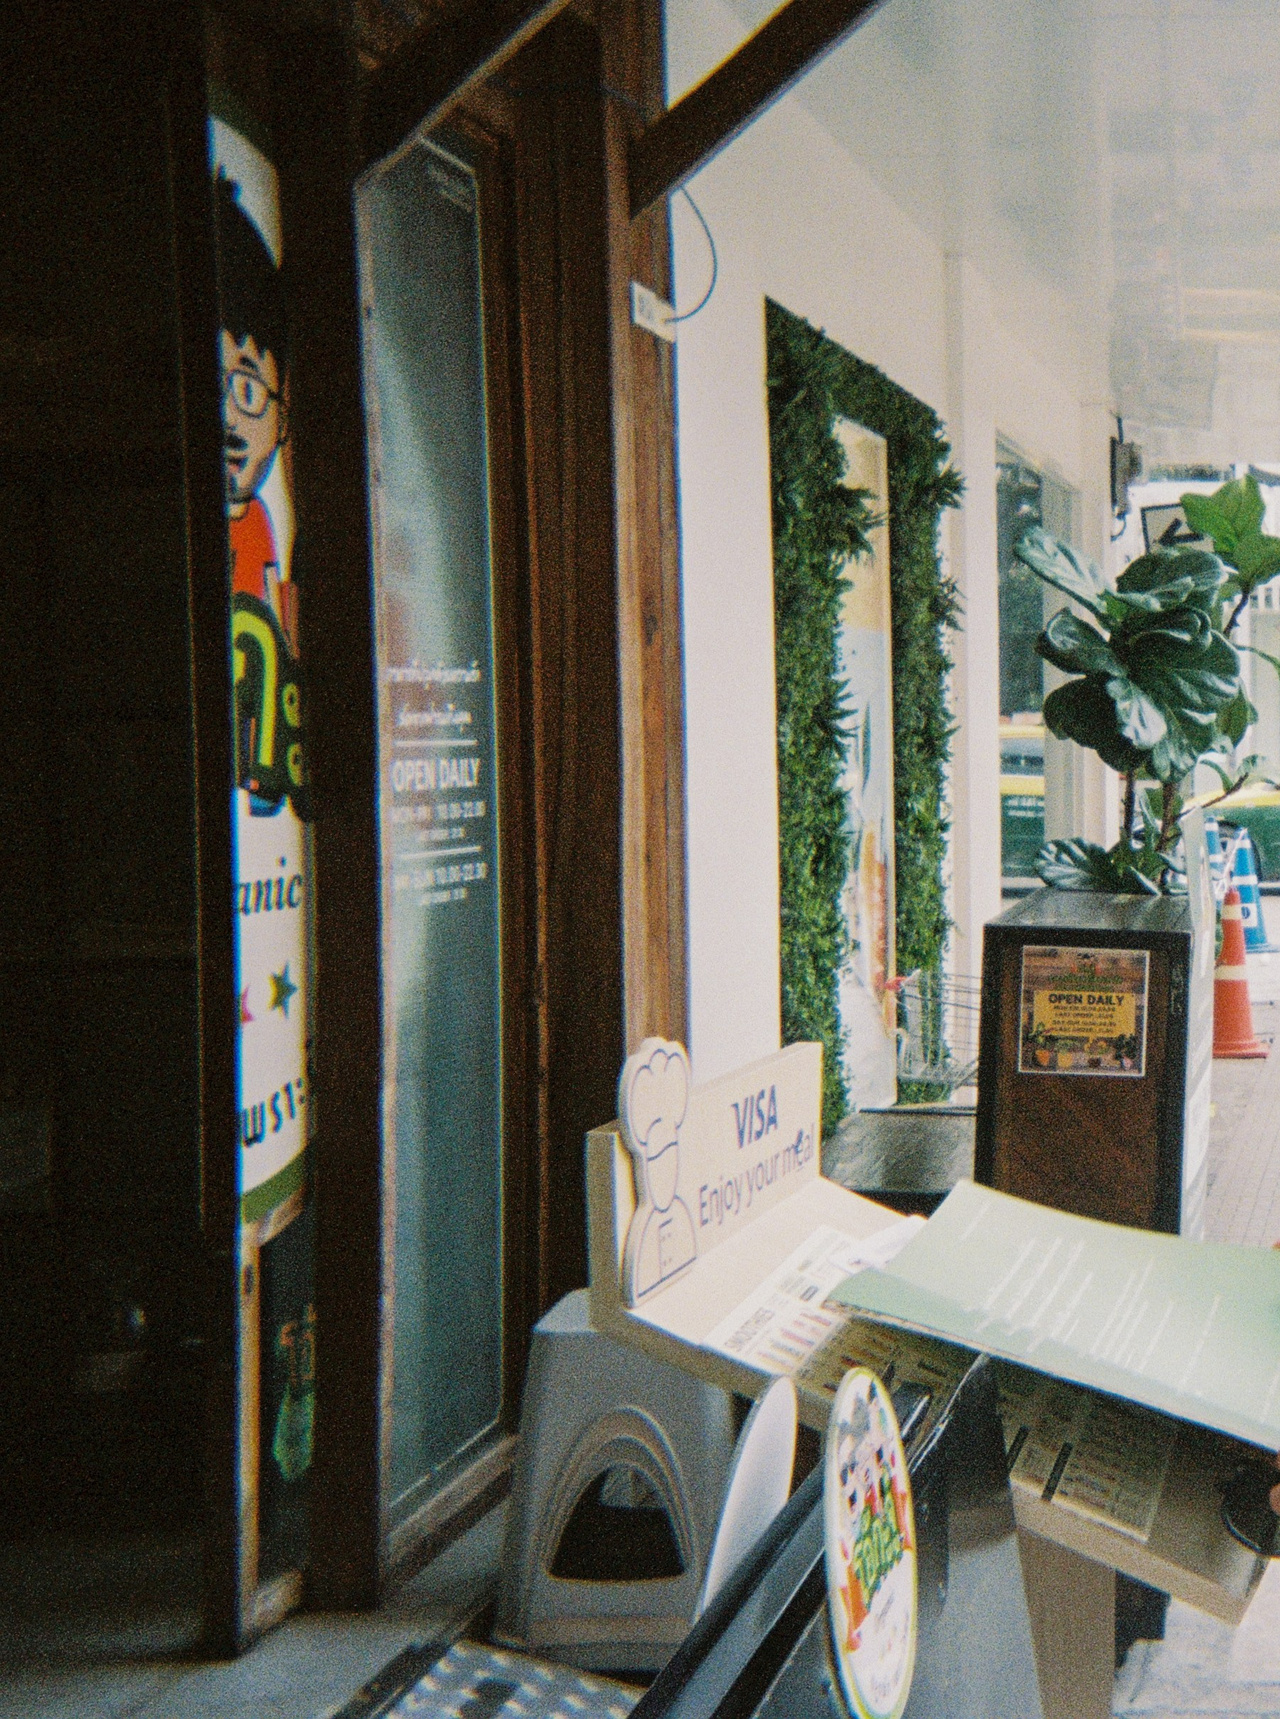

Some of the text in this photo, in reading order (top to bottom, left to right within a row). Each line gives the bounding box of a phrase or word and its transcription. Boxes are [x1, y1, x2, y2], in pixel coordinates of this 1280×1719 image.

[391, 758, 480, 792] OPEN DAILY
[1048, 993, 1125, 1007] OPEN DAILY
[731, 1084, 778, 1149] VISA
[699, 1122, 815, 1228] Enjoy your meal
